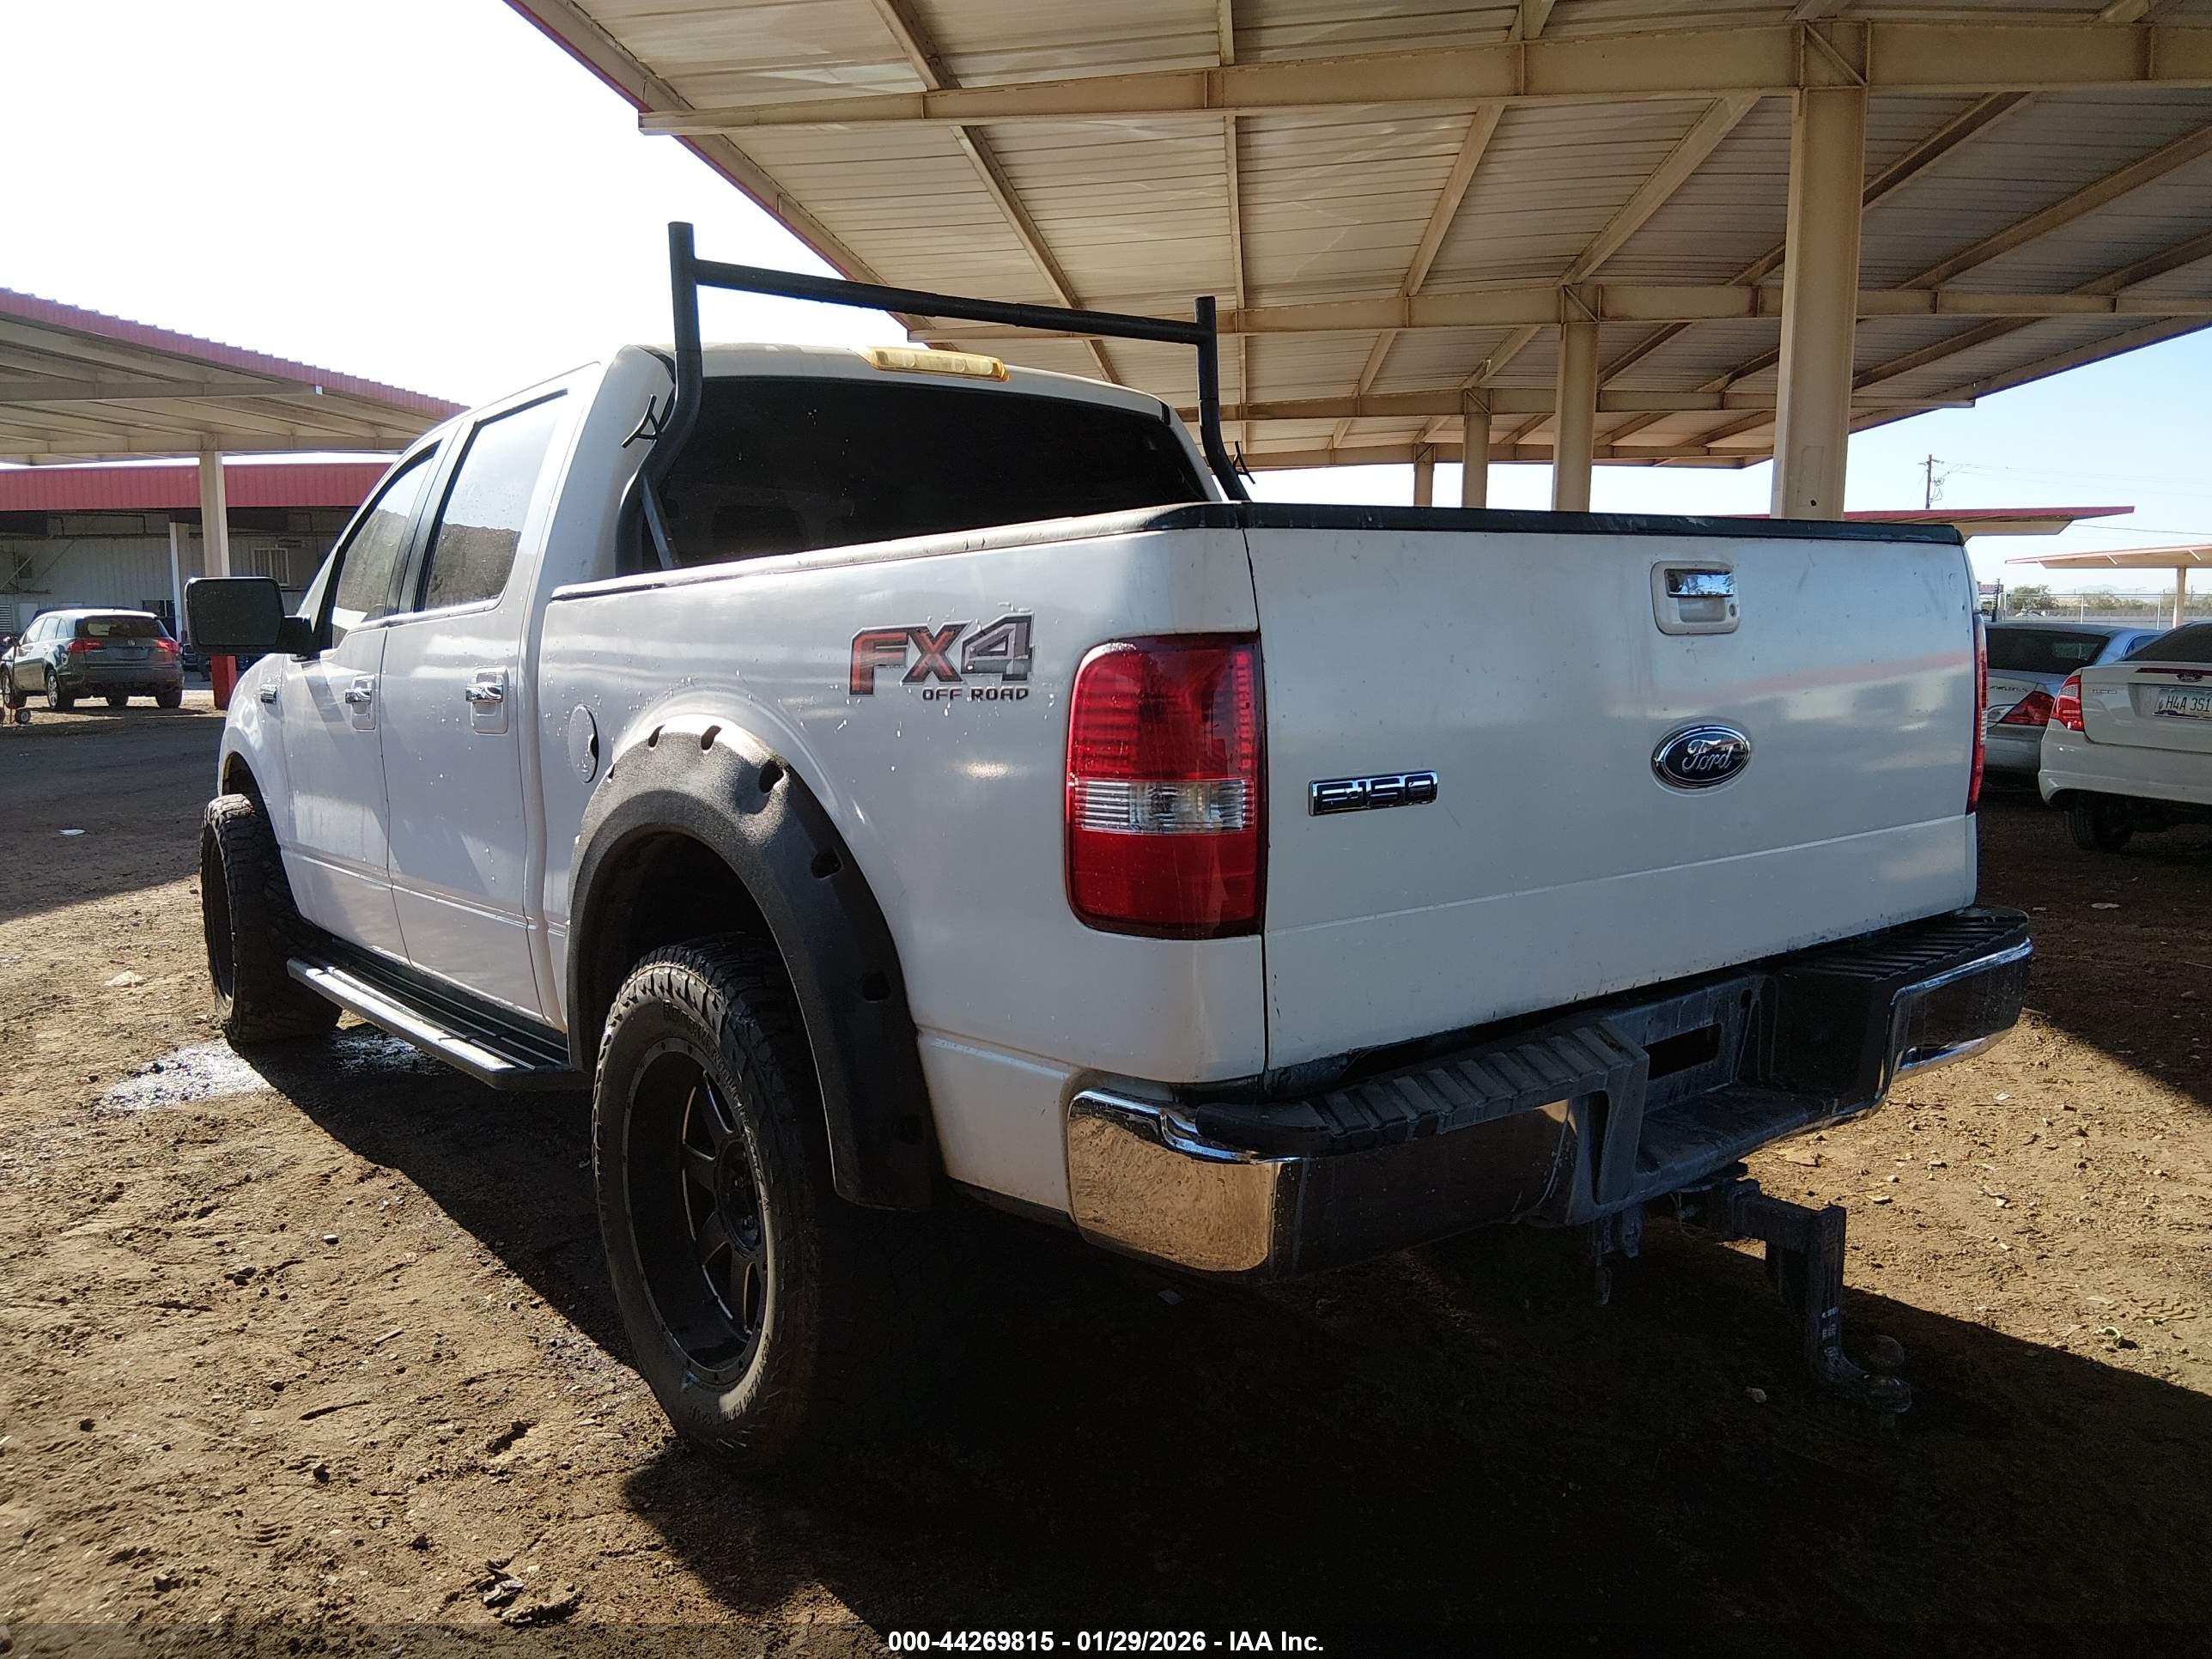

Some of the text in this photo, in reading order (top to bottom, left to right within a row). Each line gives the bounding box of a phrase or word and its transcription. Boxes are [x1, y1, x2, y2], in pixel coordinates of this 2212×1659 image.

[848, 612, 1034, 696] FX4
[922, 688, 1029, 701] OFF ROAD
[1681, 738, 1734, 771] Ford
